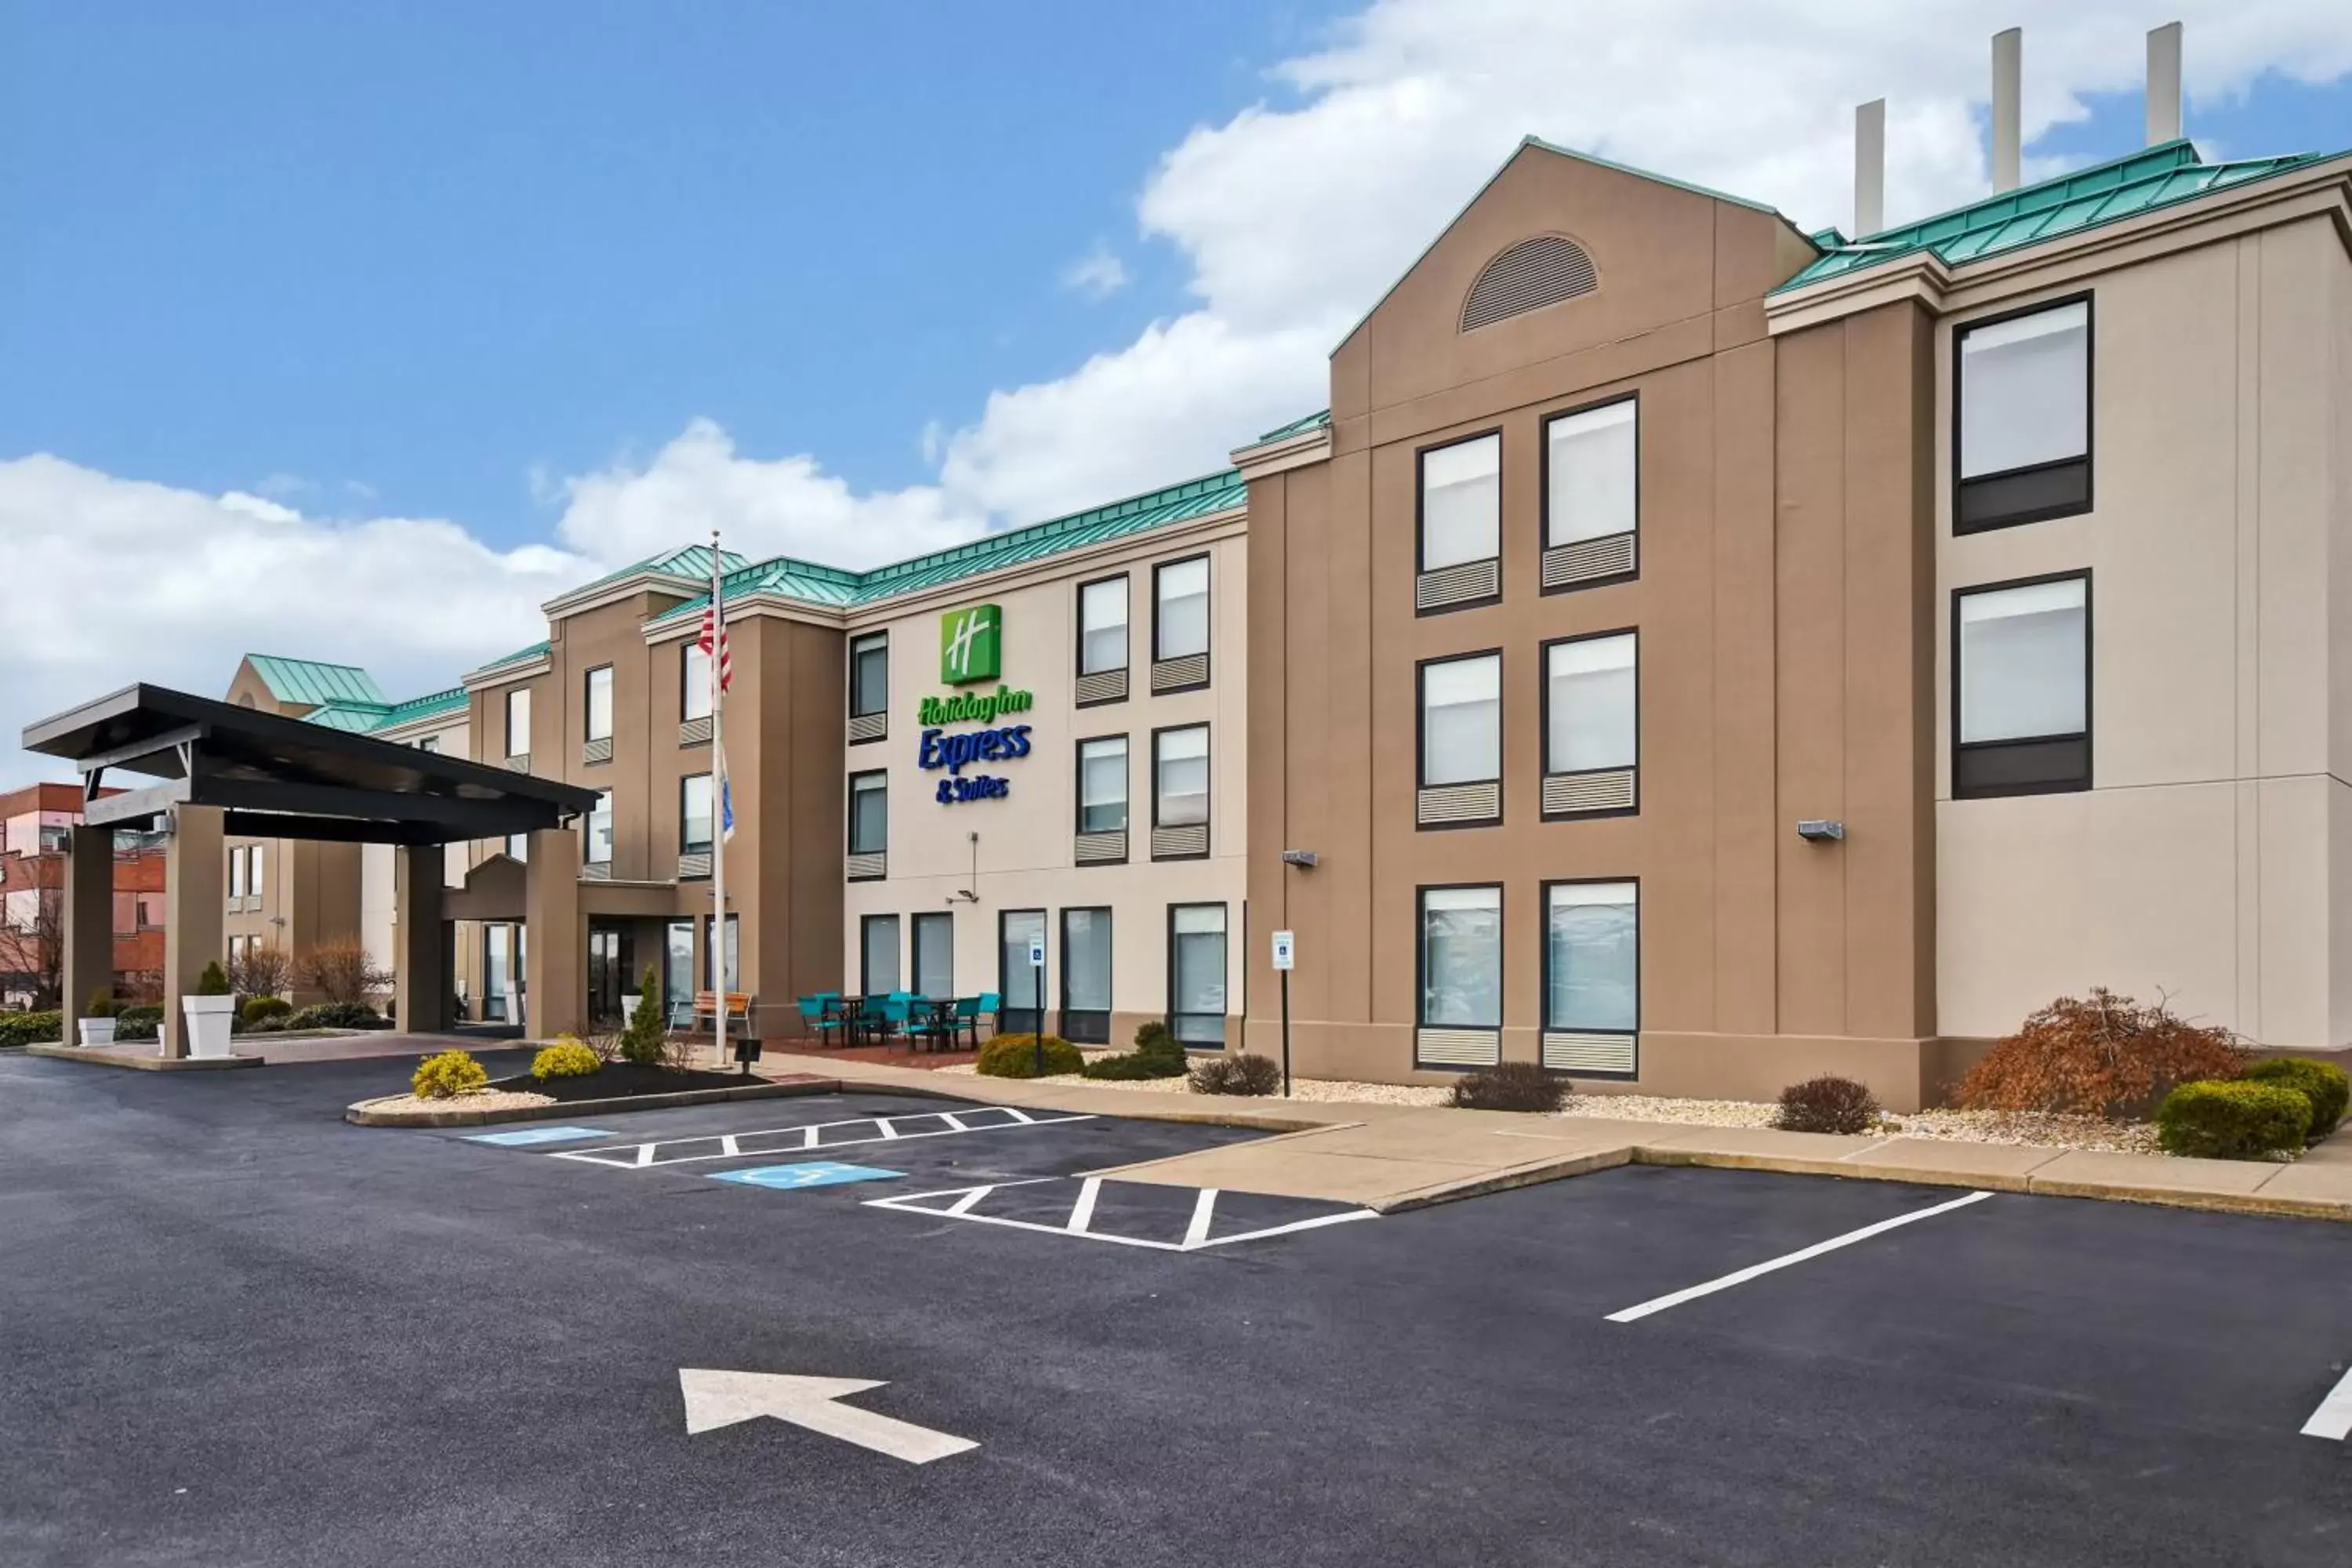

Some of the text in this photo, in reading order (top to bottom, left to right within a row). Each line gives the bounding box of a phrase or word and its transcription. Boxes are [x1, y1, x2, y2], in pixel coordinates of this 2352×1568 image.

[918, 685, 1032, 724] Holiday Inn
[919, 724, 1032, 775] Express
[936, 775, 1010, 804] & Suites
